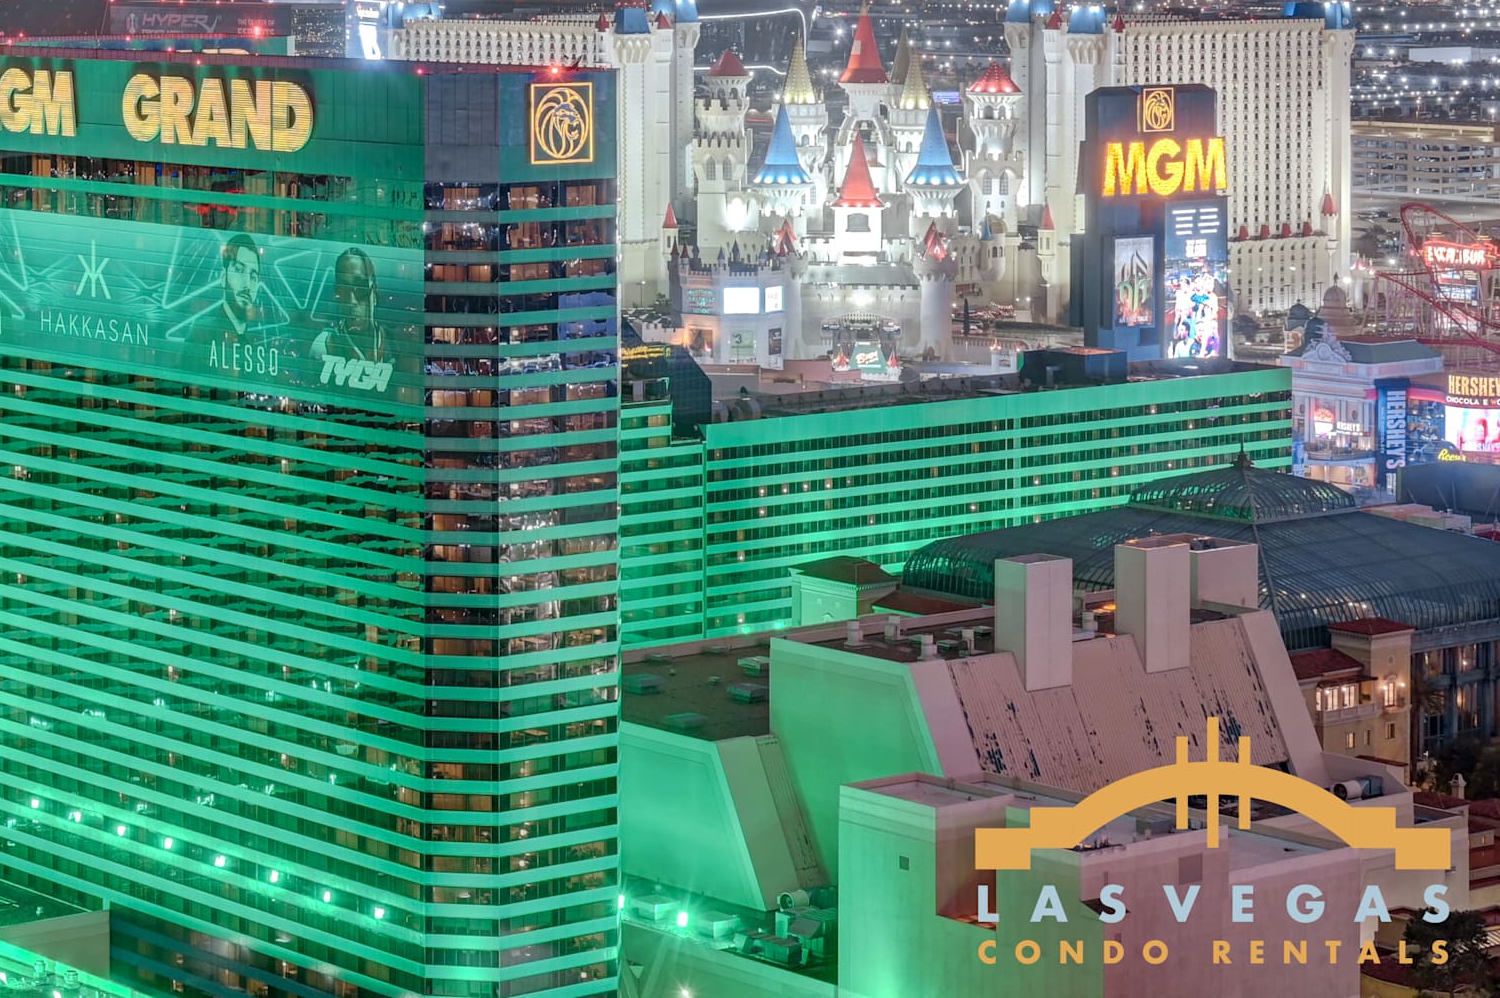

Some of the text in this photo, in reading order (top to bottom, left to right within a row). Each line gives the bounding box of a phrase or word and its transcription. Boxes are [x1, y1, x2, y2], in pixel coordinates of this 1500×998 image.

[122, 73, 315, 153] GRAND
[1102, 138, 1227, 196] MGM
[40, 309, 149, 347] HAKKASAN
[209, 340, 279, 377] ALESSO
[319, 354, 394, 393] TYGA
